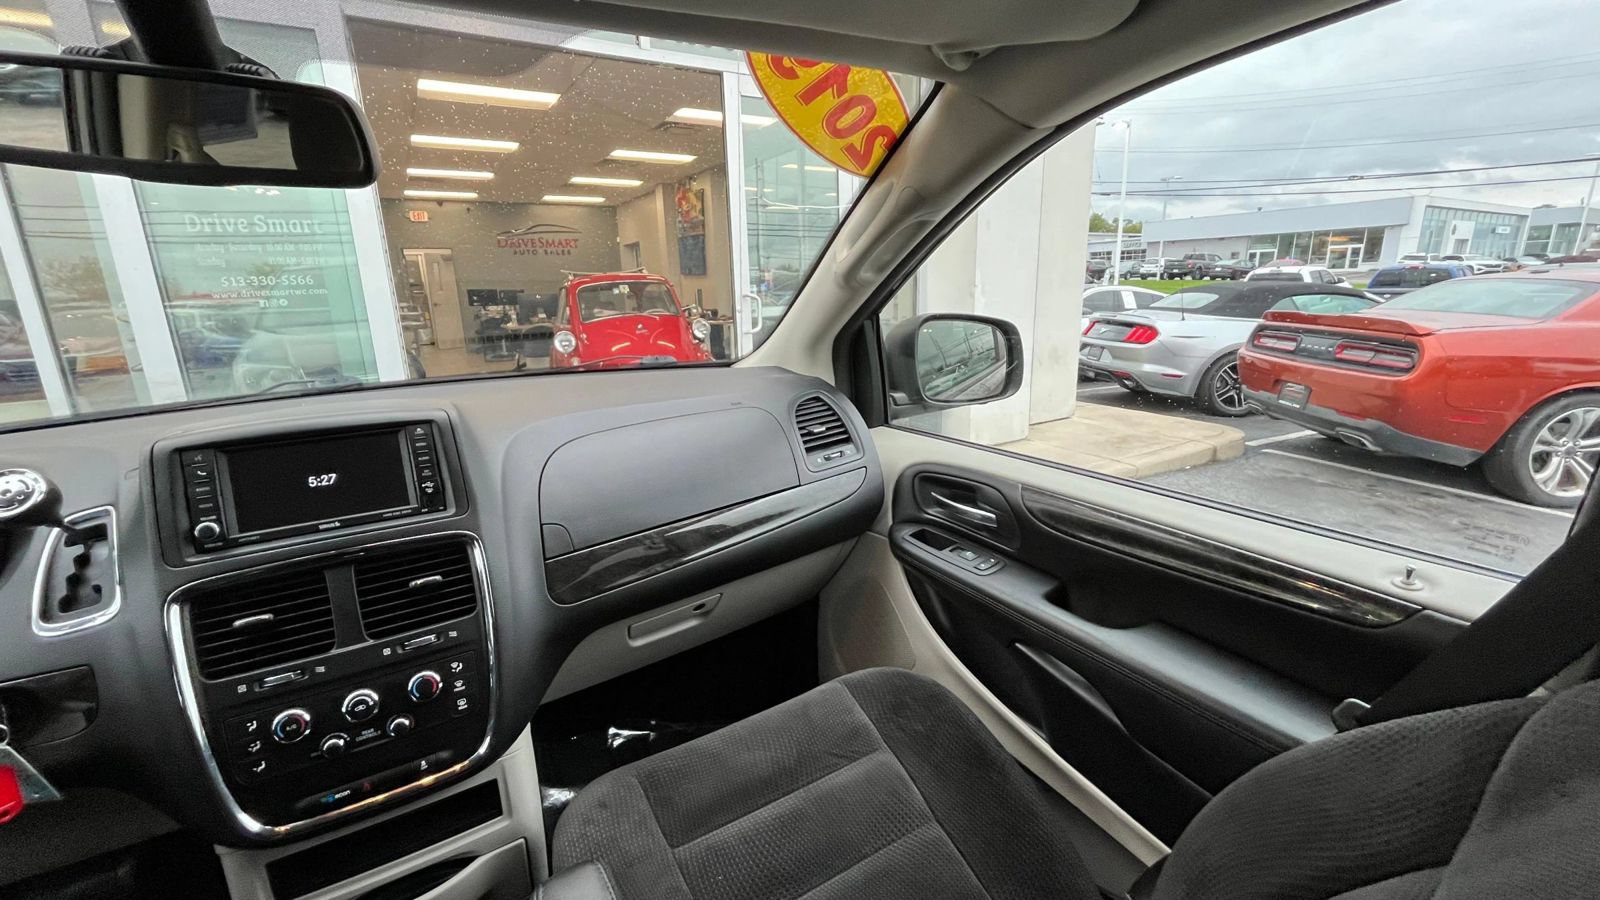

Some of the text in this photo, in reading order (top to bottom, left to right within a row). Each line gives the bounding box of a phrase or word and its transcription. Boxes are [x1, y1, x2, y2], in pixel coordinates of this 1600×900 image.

[184, 213, 323, 234] Drive Smart
[513, 248, 572, 256] AUTO SALES
[221, 275, 314, 287] 513-330-5566
[308, 473, 337, 487] 5:27
